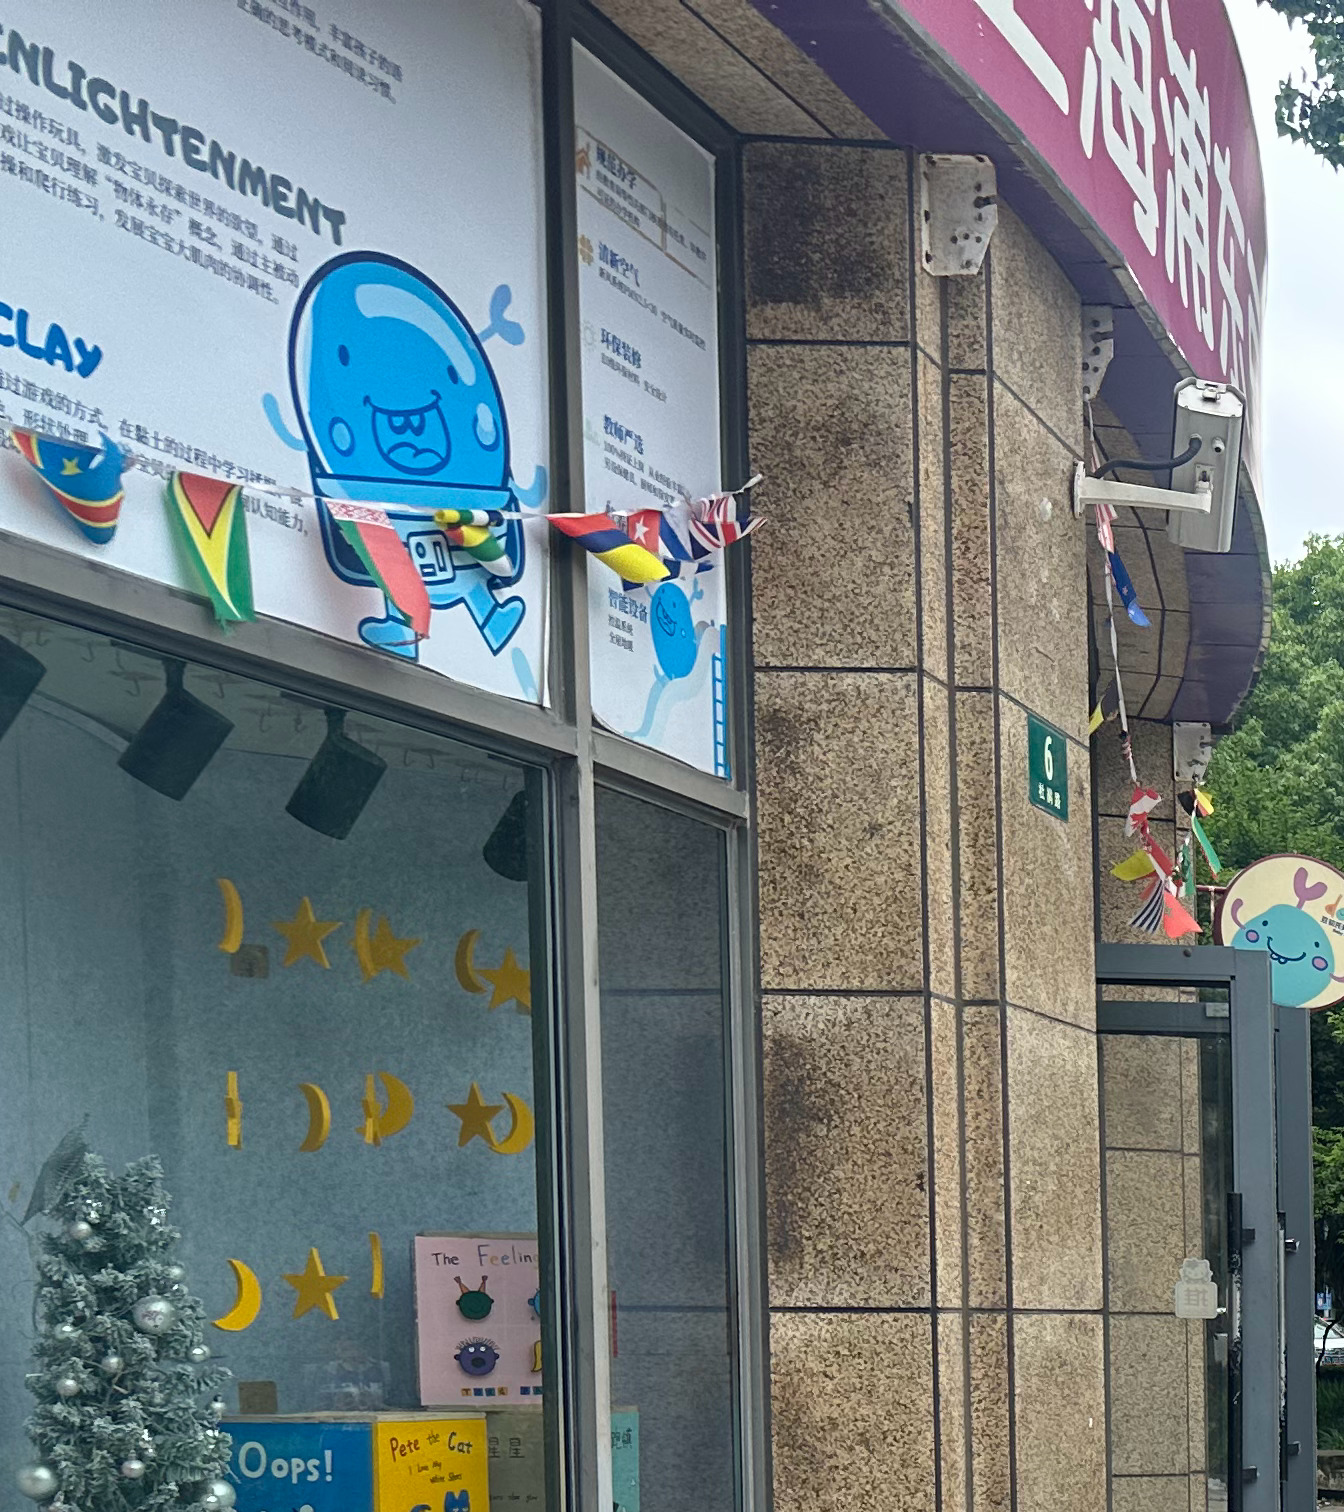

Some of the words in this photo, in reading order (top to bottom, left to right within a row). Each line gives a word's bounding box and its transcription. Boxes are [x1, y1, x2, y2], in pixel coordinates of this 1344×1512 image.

[0, 24, 347, 246] NLIGHTENMENT
[1044, 735, 1054, 781] 6
[431, 1251, 460, 1266] The
[238, 1441, 333, 1485] Oops!
[389, 1437, 420, 1462] Pete
[447, 1431, 473, 1455] Cat
